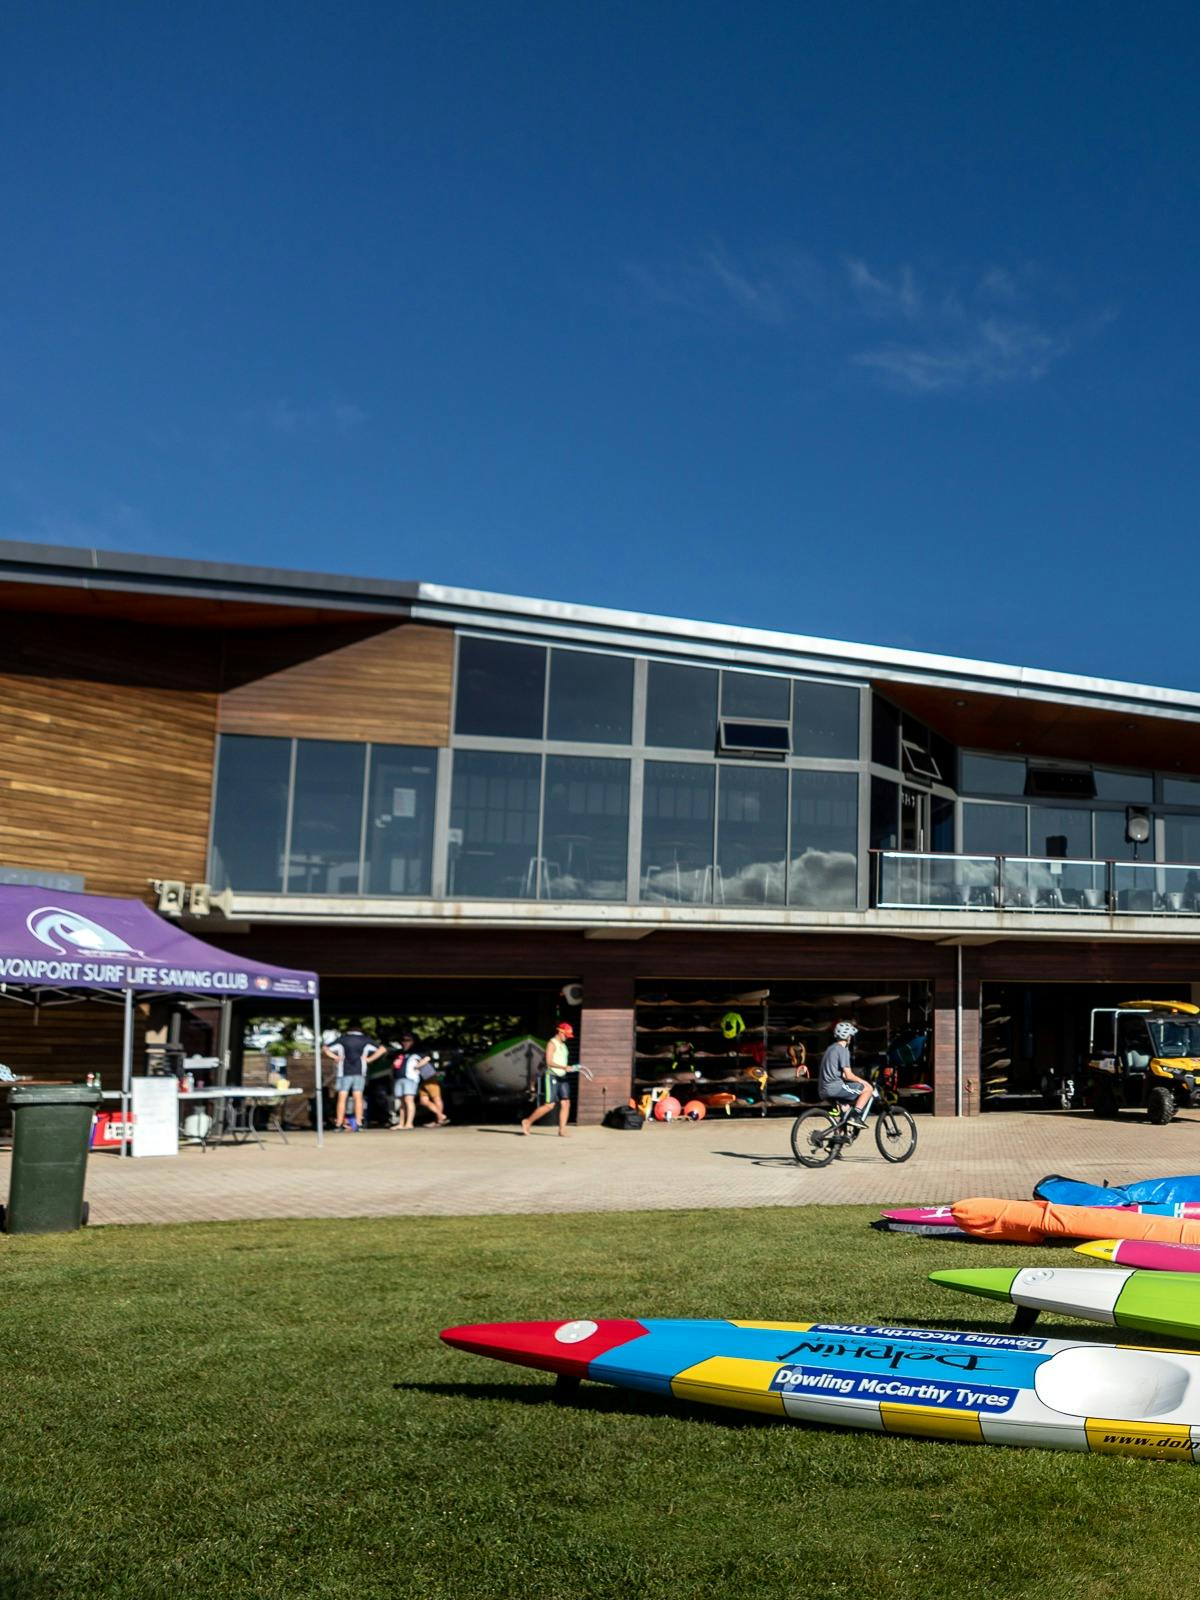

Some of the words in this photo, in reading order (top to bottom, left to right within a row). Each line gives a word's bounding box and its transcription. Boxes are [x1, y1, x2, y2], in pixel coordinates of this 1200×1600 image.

[83, 962, 125, 983] SURF
[126, 966, 158, 985] LIFE
[159, 967, 212, 988] SAVING
[212, 971, 249, 990] CLUB
[817, 1324, 867, 1335] Tyres
[872, 1327, 959, 1342] McCarthy
[962, 1333, 1043, 1350] Dowling
[775, 1368, 855, 1395] Dowling
[858, 1379, 953, 1403] McCarthy
[956, 1388, 1010, 1408] Tyres
